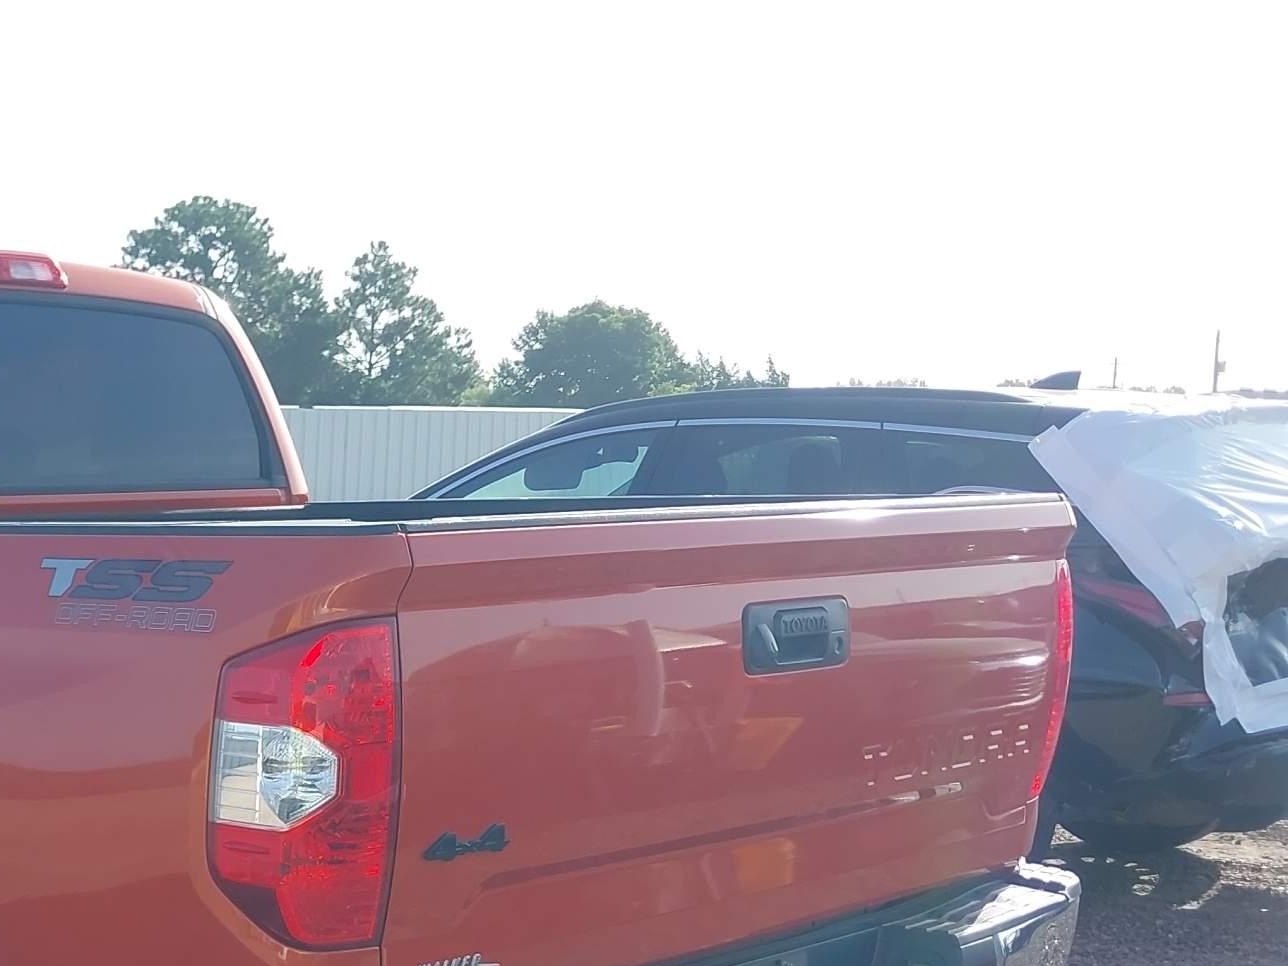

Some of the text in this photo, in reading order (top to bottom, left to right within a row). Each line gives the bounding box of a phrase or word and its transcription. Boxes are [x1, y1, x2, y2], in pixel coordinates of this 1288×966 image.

[40, 557, 233, 603] TSS
[55, 602, 217, 633] OFF-ROAD
[781, 615, 827, 633] TOYOTA
